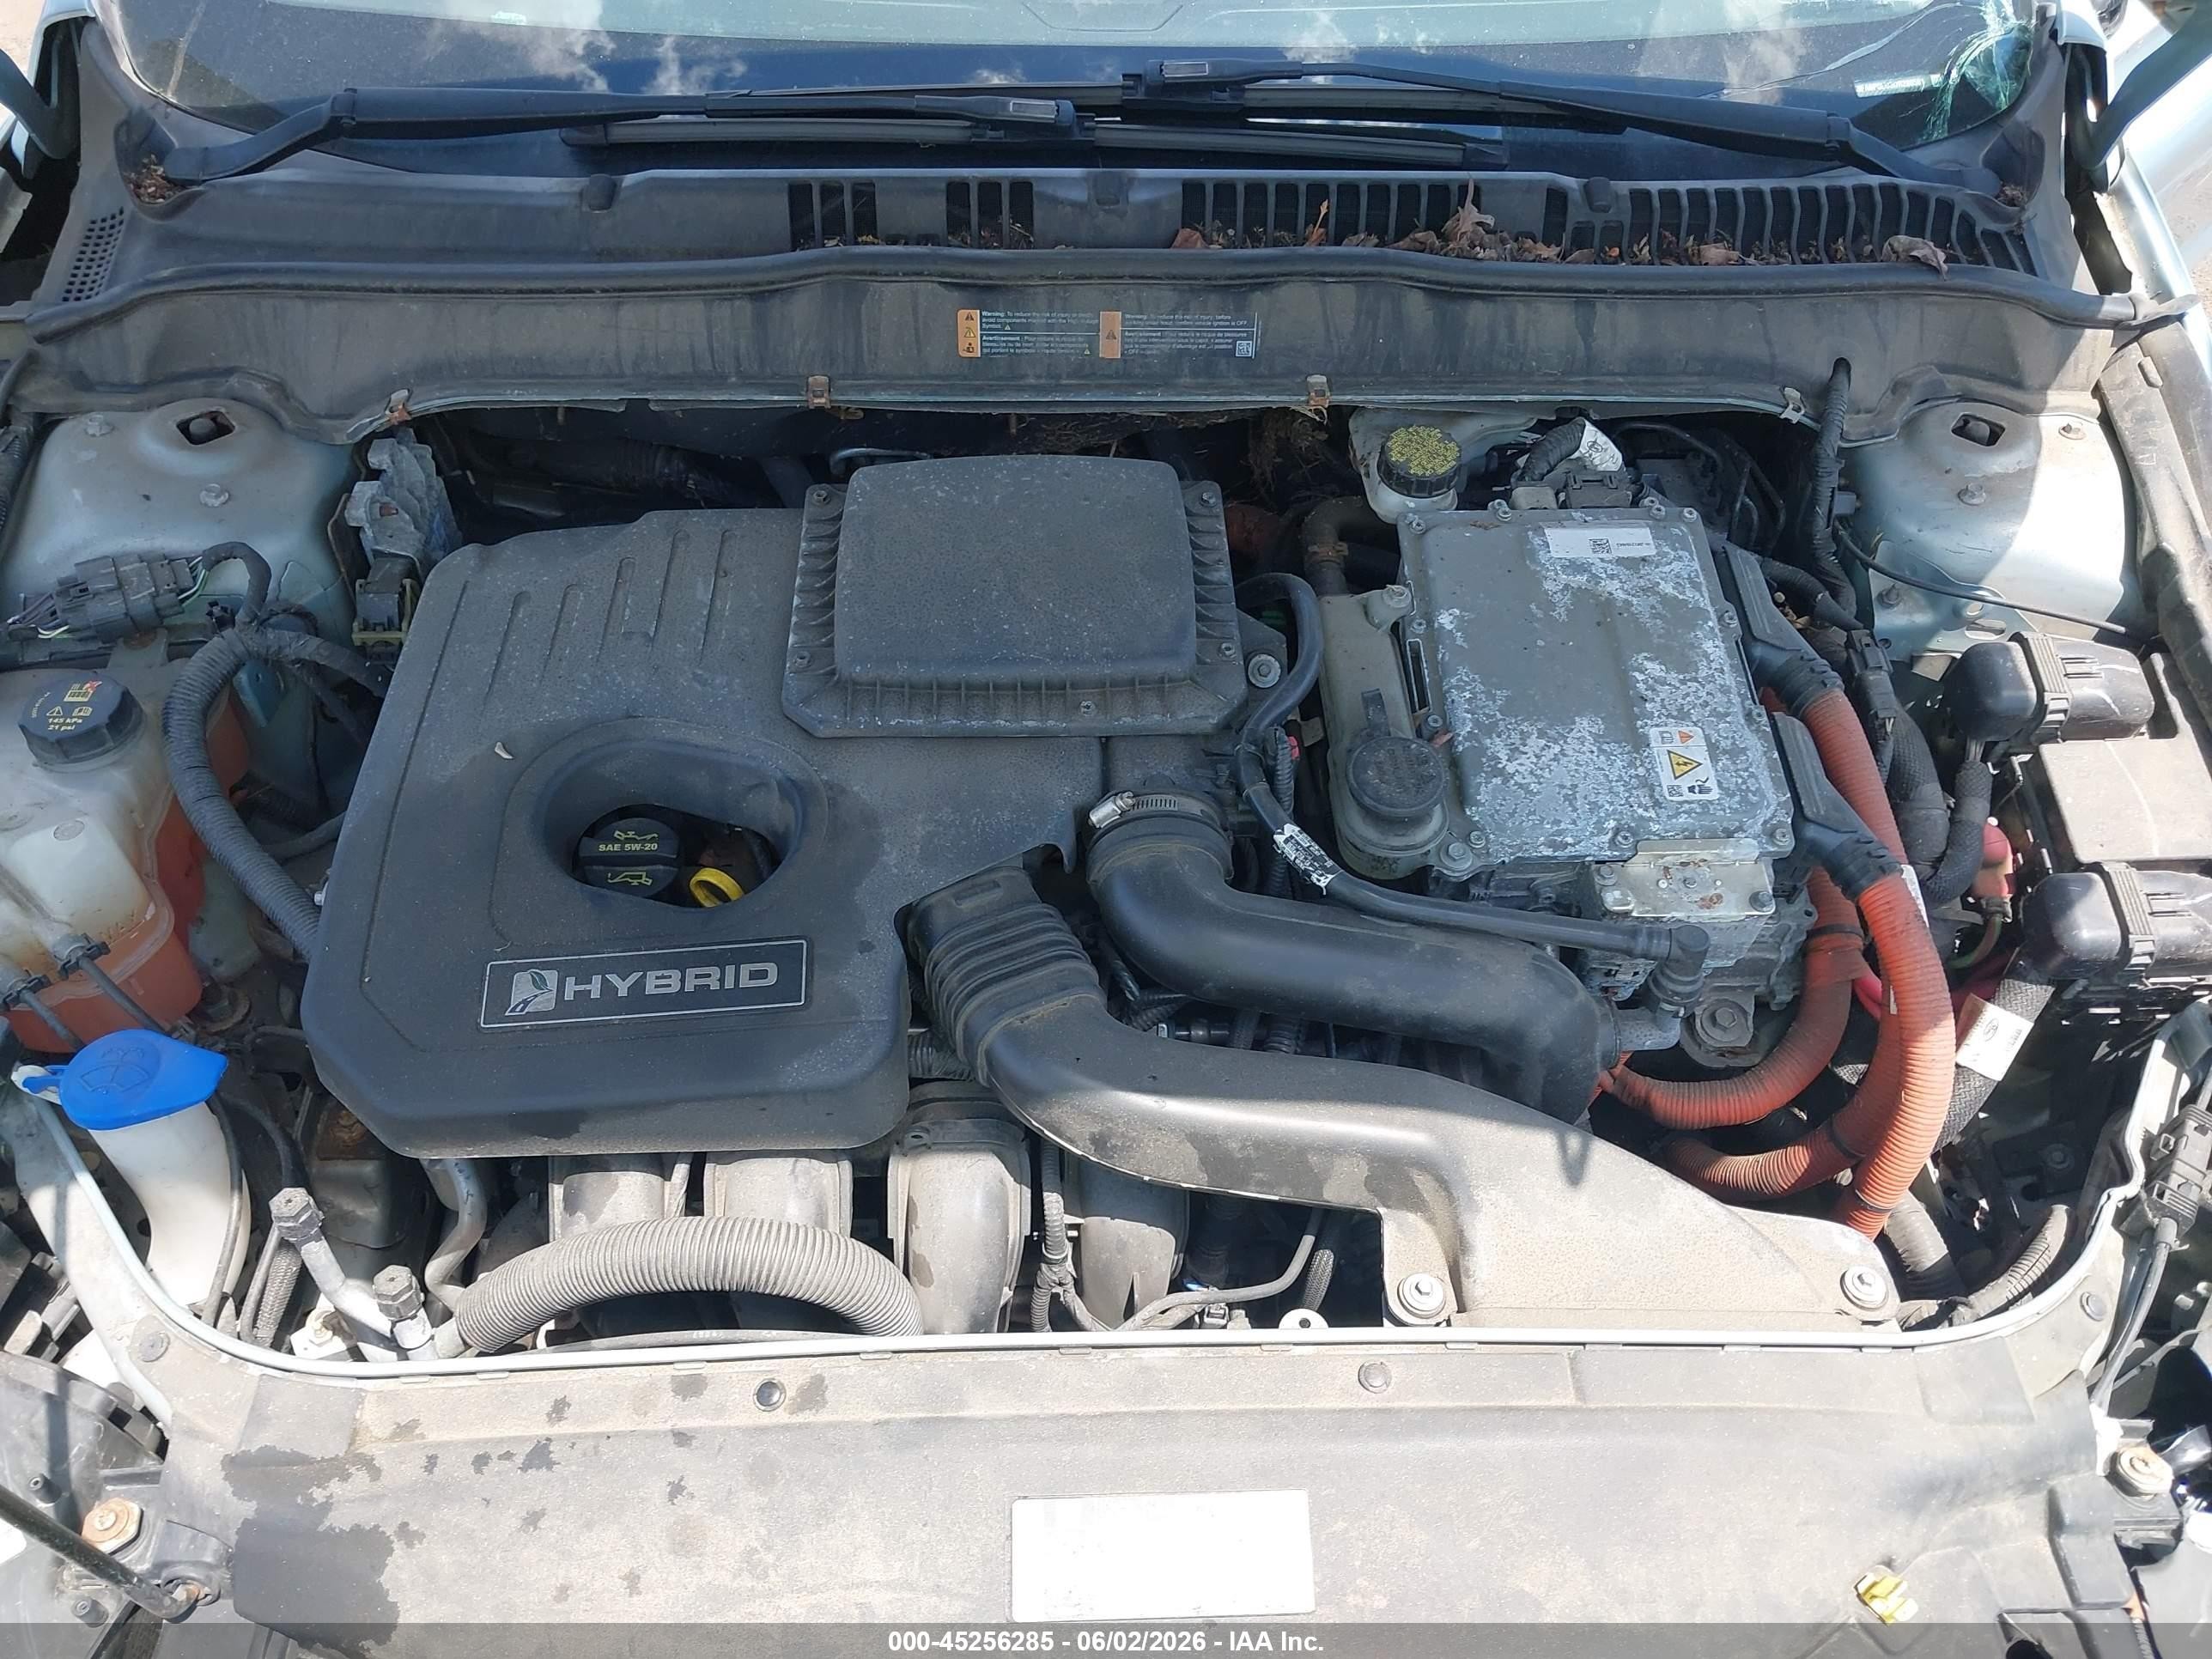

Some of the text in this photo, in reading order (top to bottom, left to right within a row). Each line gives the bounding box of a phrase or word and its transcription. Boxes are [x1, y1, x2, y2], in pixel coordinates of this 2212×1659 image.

[599, 842, 659, 852] SAE 5W-20
[563, 962, 779, 1001] HYBRID
